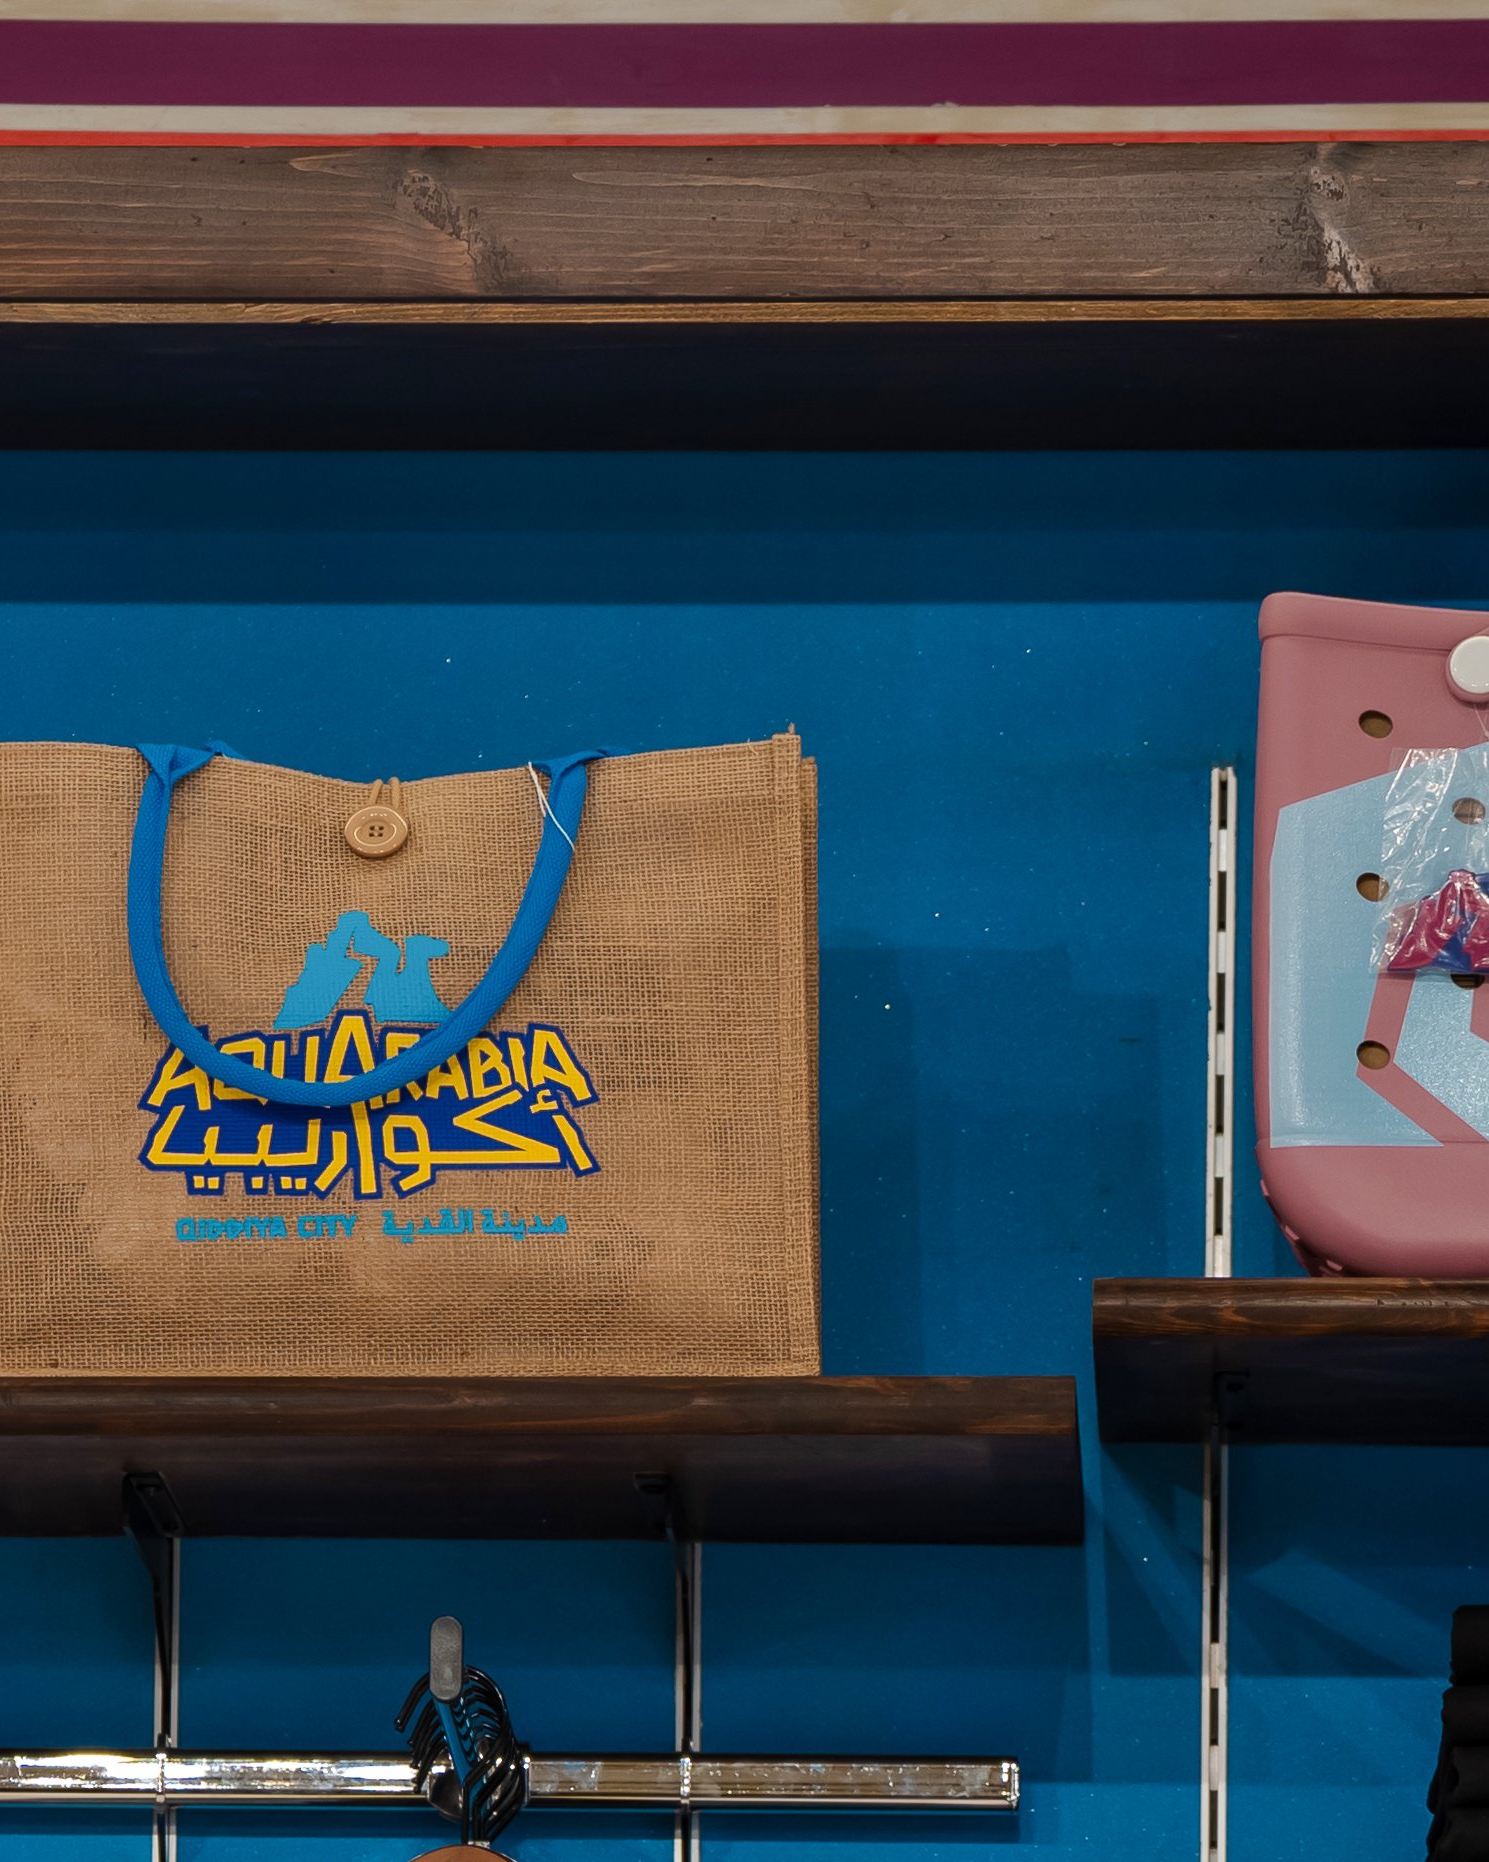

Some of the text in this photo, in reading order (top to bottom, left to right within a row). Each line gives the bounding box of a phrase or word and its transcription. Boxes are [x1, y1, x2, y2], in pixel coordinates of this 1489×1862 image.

[176, 1214, 357, 1242] QIDDIYA CITY
[481, 1209, 568, 1241] مدينة
